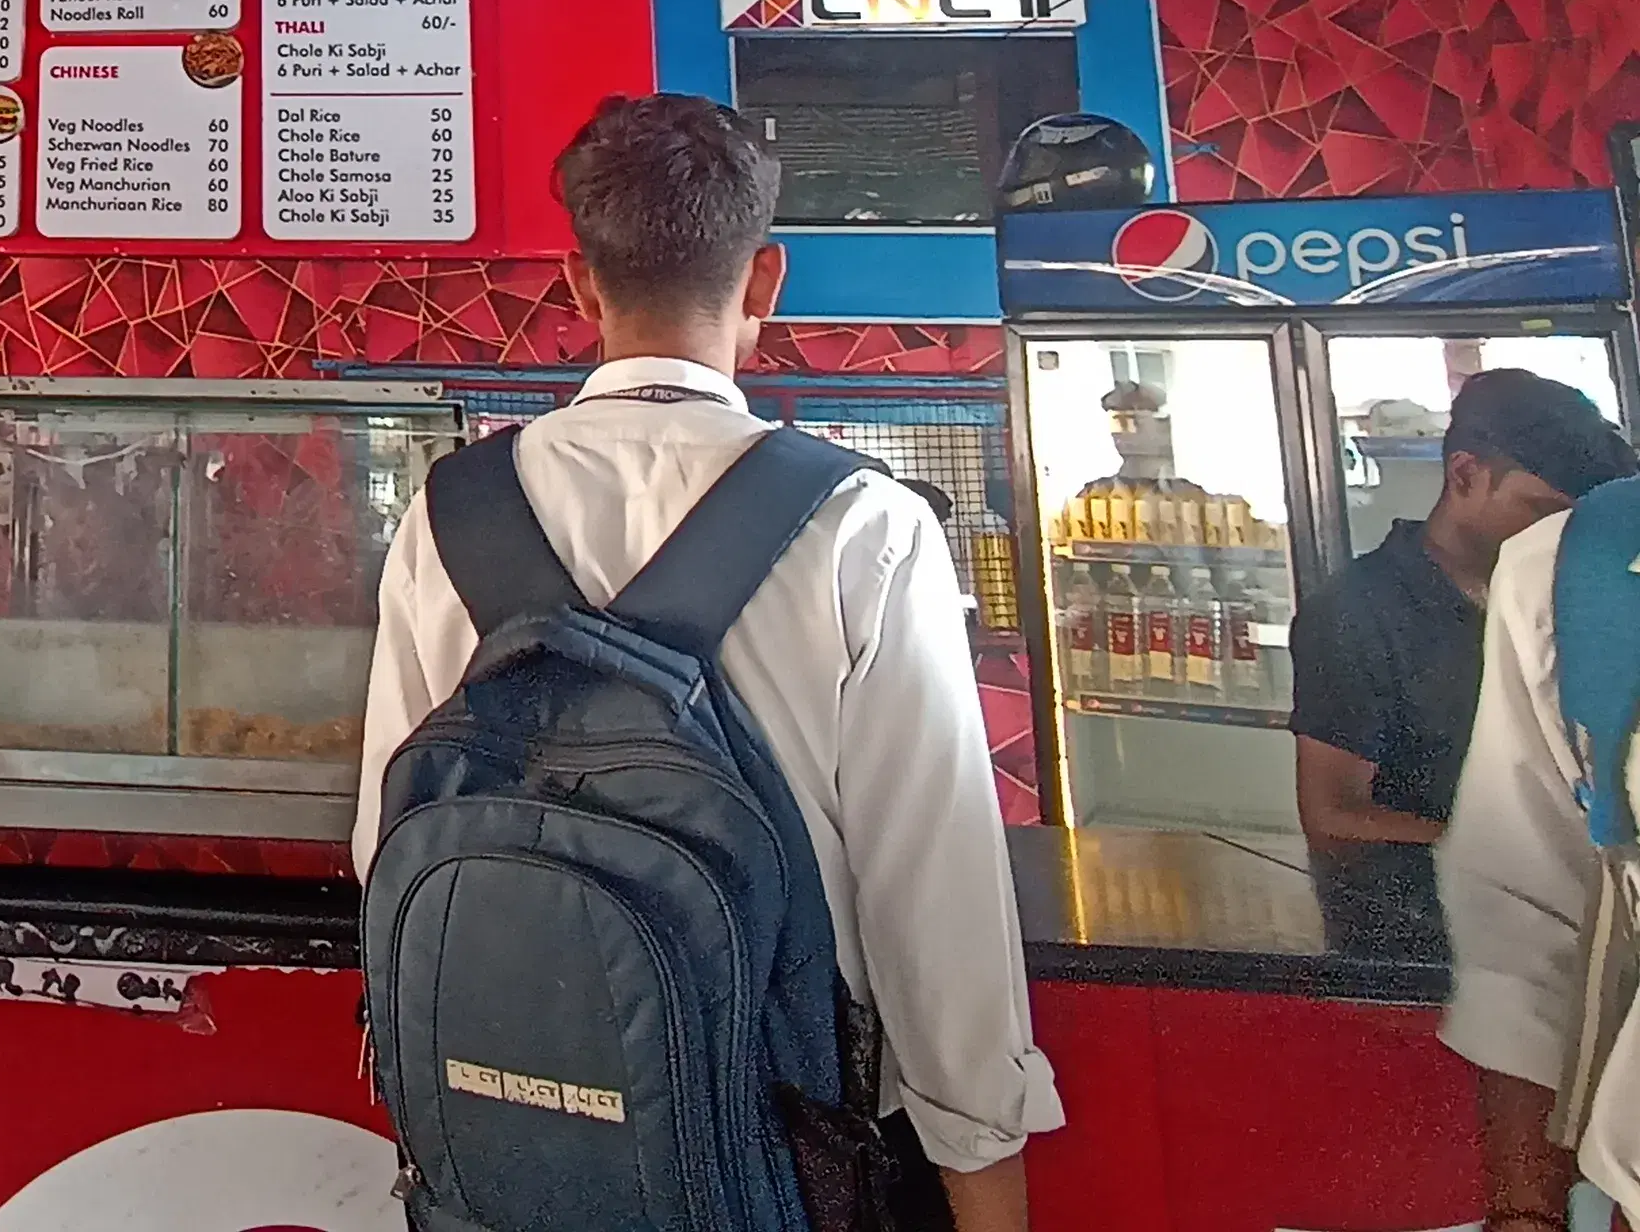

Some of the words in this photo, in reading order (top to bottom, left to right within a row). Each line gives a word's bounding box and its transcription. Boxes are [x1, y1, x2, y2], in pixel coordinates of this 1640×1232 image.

[50, 7, 112, 21] Noodles
[117, 6, 144, 20] Roll
[208, 4, 228, 18] 60
[275, 21, 325, 34] THALI
[422, 15, 456, 30] 60/-
[277, 43, 323, 58] Chole
[328, 44, 343, 57] Ki
[348, 43, 386, 61] Sabji
[50, 66, 119, 79] CHINESE
[277, 63, 287, 77] 6
[293, 63, 322, 77] Puri
[346, 62, 390, 77] Salad
[414, 62, 461, 76] Achar
[278, 108, 304, 122] Dal
[310, 108, 340, 122] Rice
[430, 108, 452, 122] 50
[48, 118, 76, 135] Veg
[81, 118, 144, 132] Noodles
[208, 119, 229, 133] 60
[278, 128, 324, 143] Chole
[329, 128, 360, 143] Rice
[431, 128, 452, 142] 60
[127, 138, 190, 152] Noodles
[208, 138, 229, 152] 70
[278, 148, 324, 163] Chole
[432, 148, 453, 162] 70
[47, 157, 75, 174] Veg
[80, 157, 118, 171] Fried
[123, 158, 153, 172] Rice
[208, 158, 228, 173] 60
[278, 168, 324, 183] Chole
[330, 168, 391, 183] Samosa
[432, 168, 453, 182] 25
[46, 177, 75, 194] Veg
[79, 177, 170, 191] Manchurian
[208, 178, 228, 192] 60
[152, 197, 182, 212] Rice
[208, 198, 228, 212] 80
[278, 188, 314, 203] Aloo
[319, 188, 334, 202] Ki
[339, 188, 378, 207] Sabji
[432, 188, 454, 203] 25
[279, 208, 325, 223] Chole
[330, 209, 345, 222] Ki
[350, 208, 389, 227] Sabji
[433, 209, 454, 223] 35
[1236, 212, 1470, 288] pepsi
